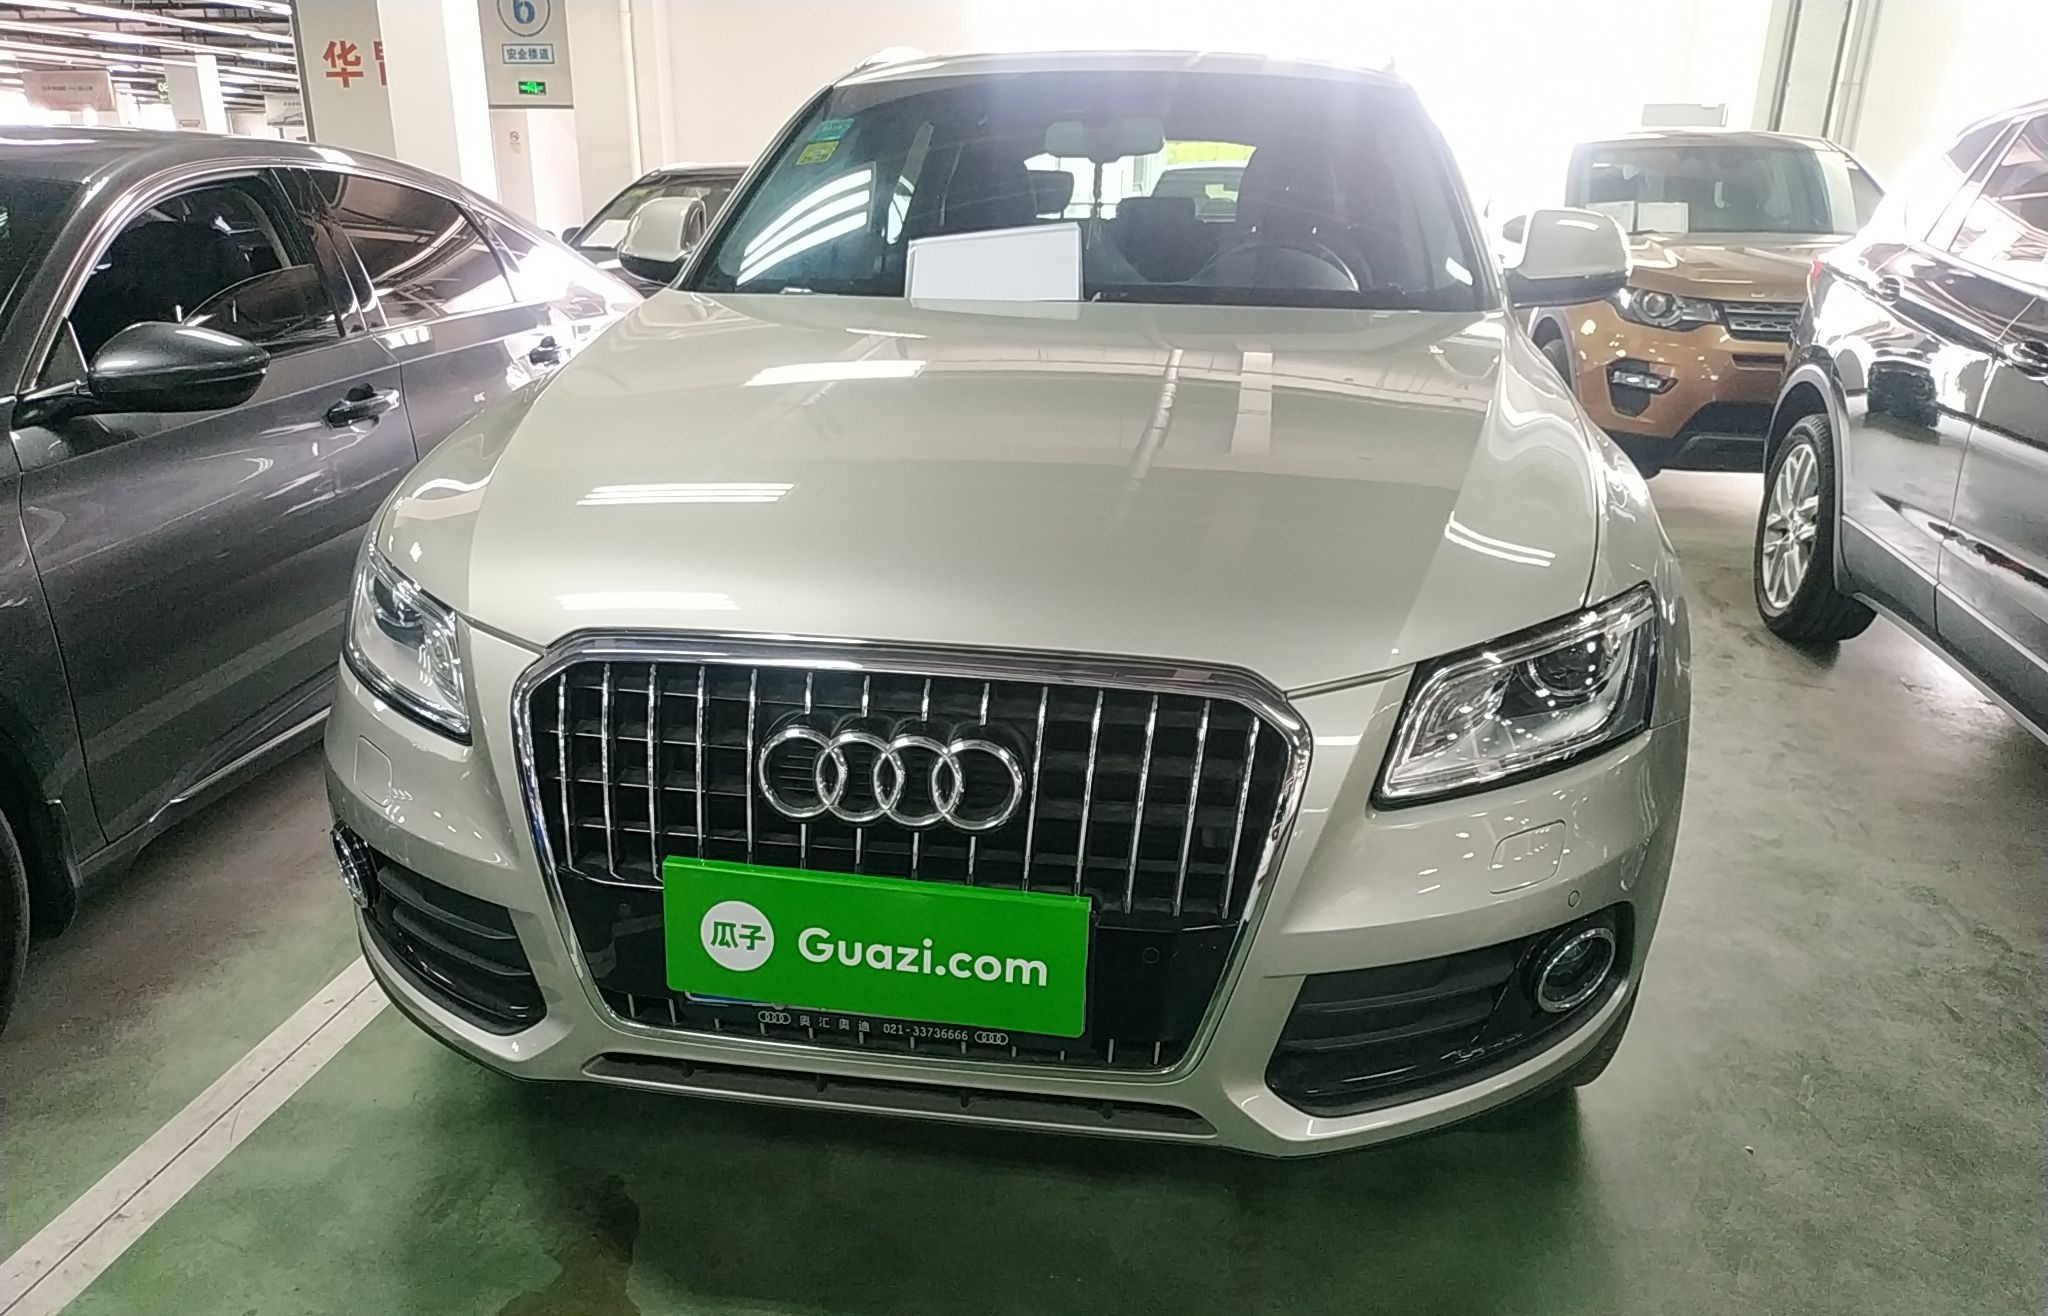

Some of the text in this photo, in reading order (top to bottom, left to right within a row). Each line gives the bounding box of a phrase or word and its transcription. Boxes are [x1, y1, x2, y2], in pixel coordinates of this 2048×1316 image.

[512, 0, 536, 25] 6
[506, 47, 551, 61] 安全楼道
[710, 920, 766, 951] 瓜子
[797, 926, 1048, 988] Guazi.com
[799, 1014, 969, 1041] 奥汇奥迪 021-33736666
